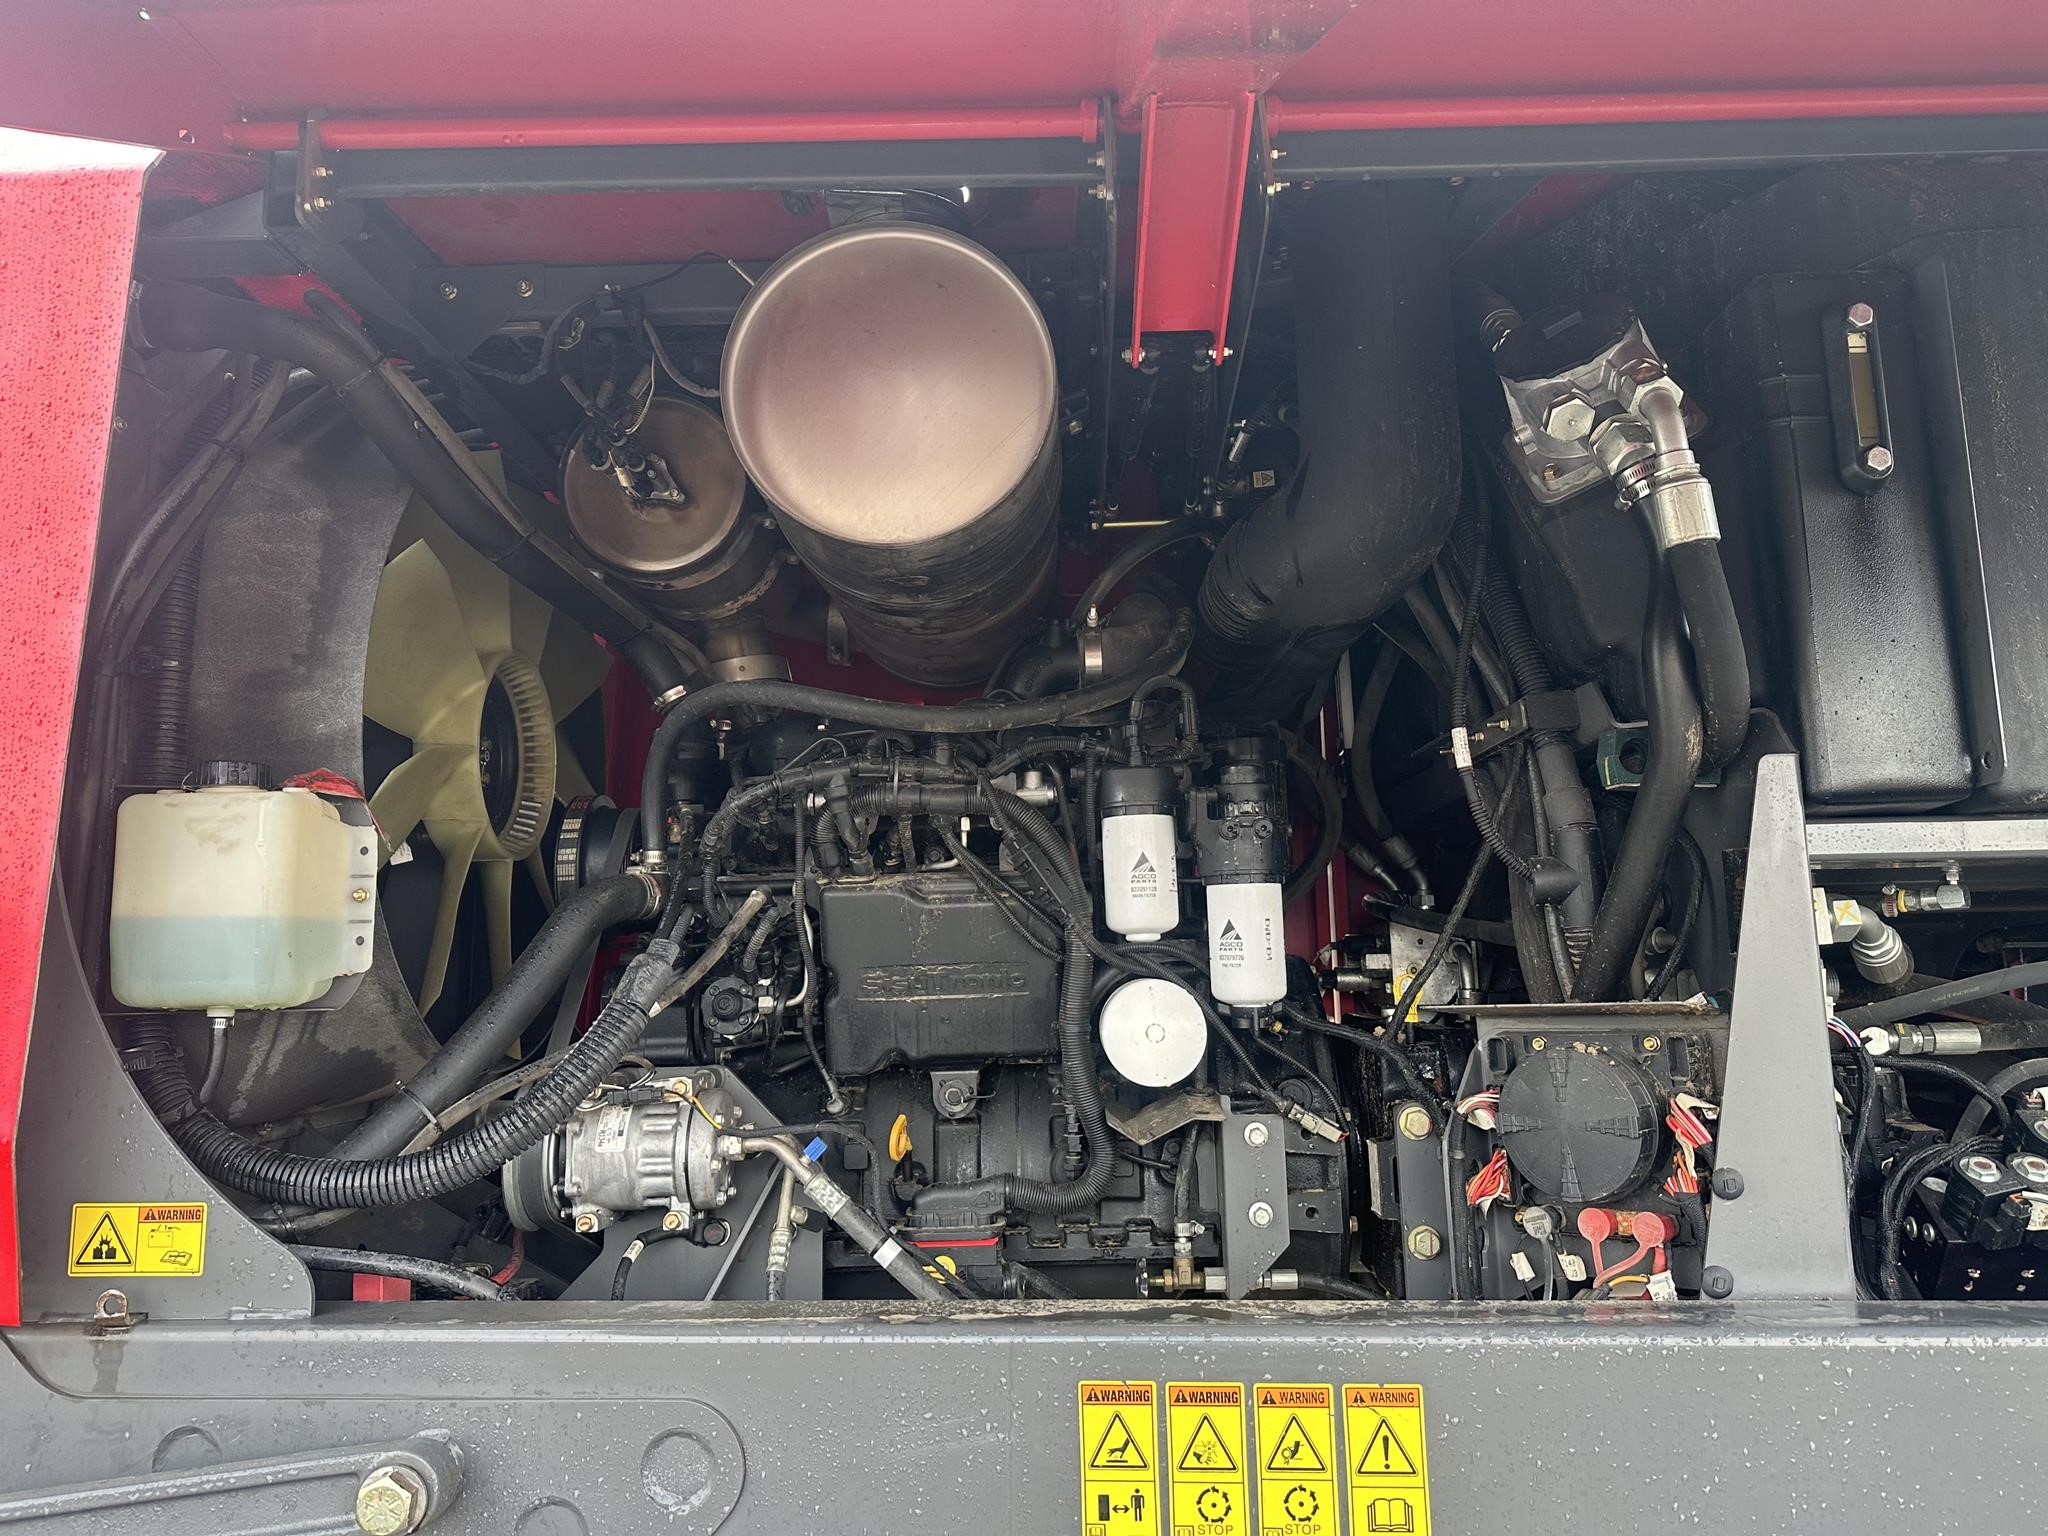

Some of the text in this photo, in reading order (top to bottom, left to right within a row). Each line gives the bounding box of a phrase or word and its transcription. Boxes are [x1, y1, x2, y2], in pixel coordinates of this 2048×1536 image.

[157, 1209, 201, 1221] WARNING
[1101, 1389, 1150, 1402] WARNING
[1188, 1391, 1238, 1403] WARNING
[1279, 1391, 1325, 1403] WARNING
[1369, 1392, 1414, 1403] WARNING
[1197, 1524, 1234, 1535] STOP
[1284, 1524, 1321, 1535] STOP
